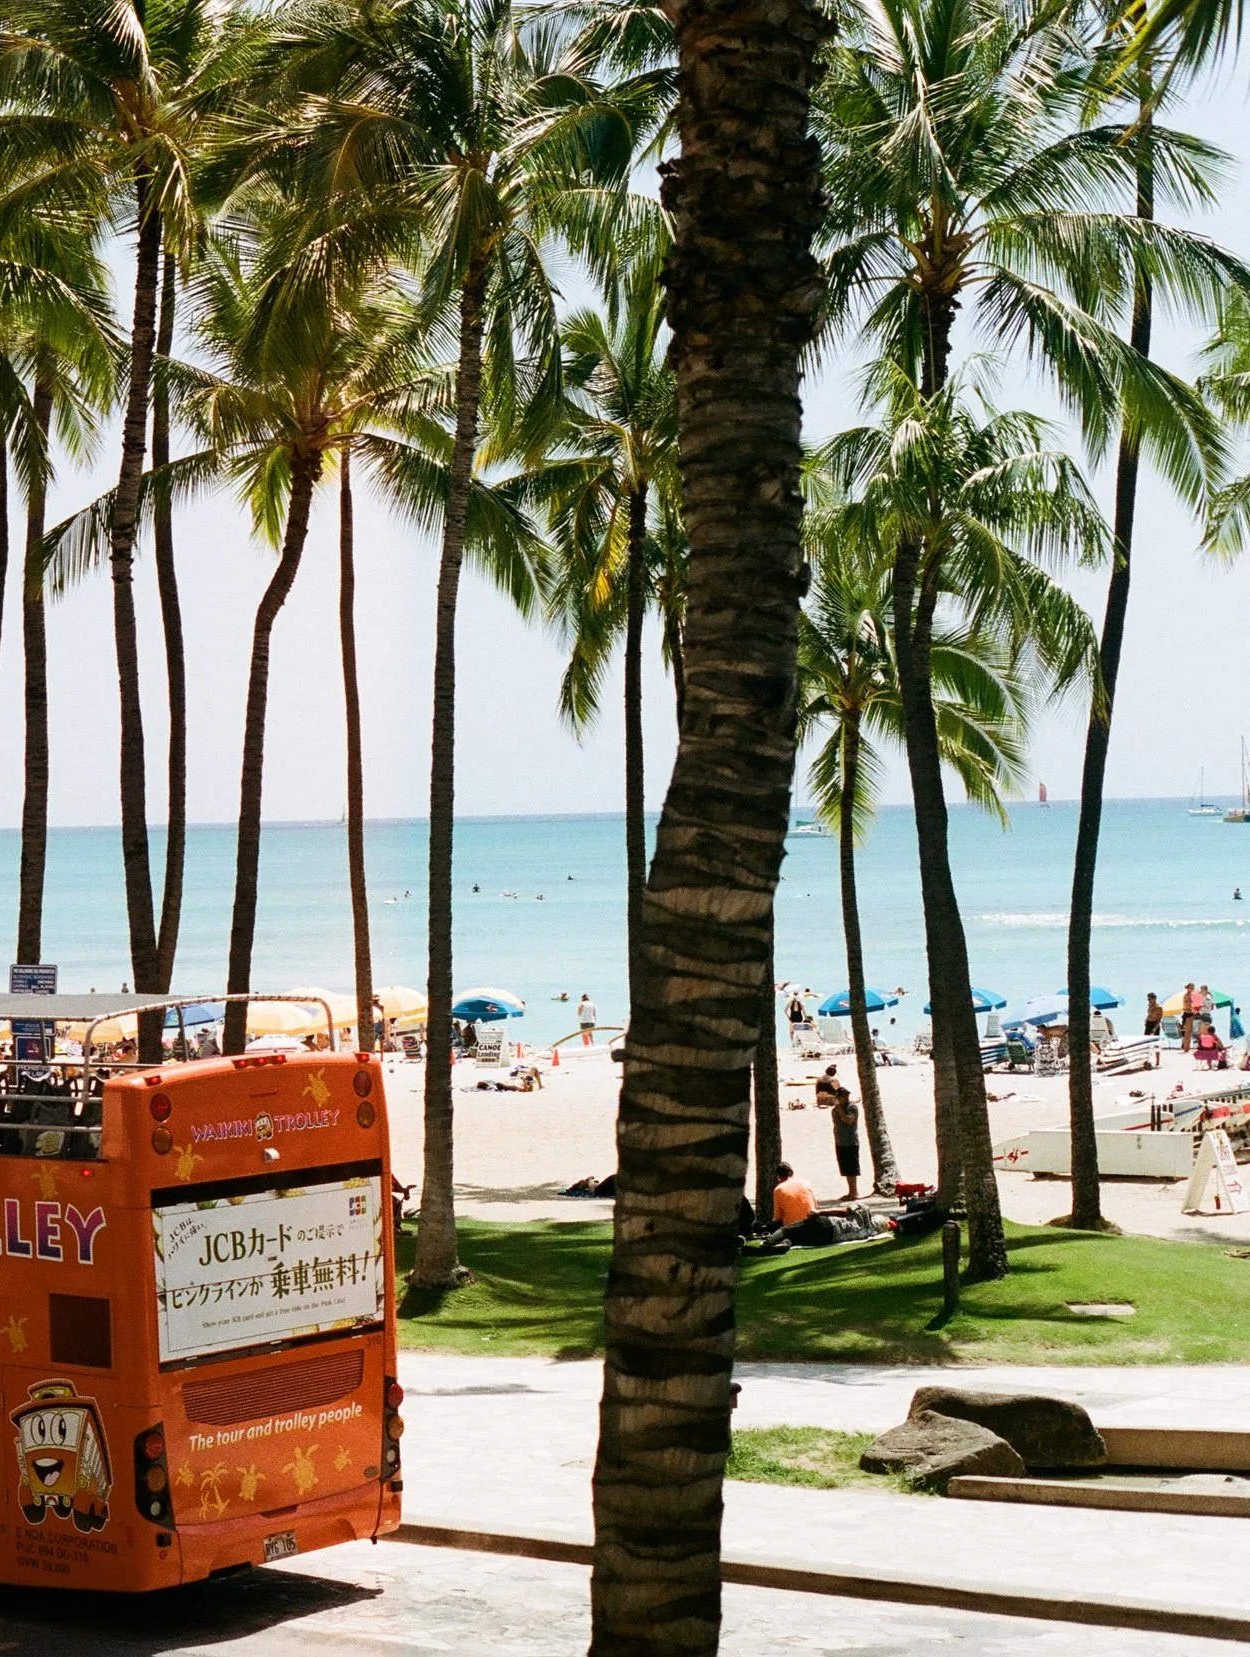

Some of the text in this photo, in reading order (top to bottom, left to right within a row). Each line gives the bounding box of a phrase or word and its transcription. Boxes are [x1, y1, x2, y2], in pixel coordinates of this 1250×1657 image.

[190, 1109, 340, 1143] WAIKIKI TROLLEY
[189, 1401, 363, 1451] The tour and trolley people
[15, 1527, 119, 1555] E NOA CORPORATION
